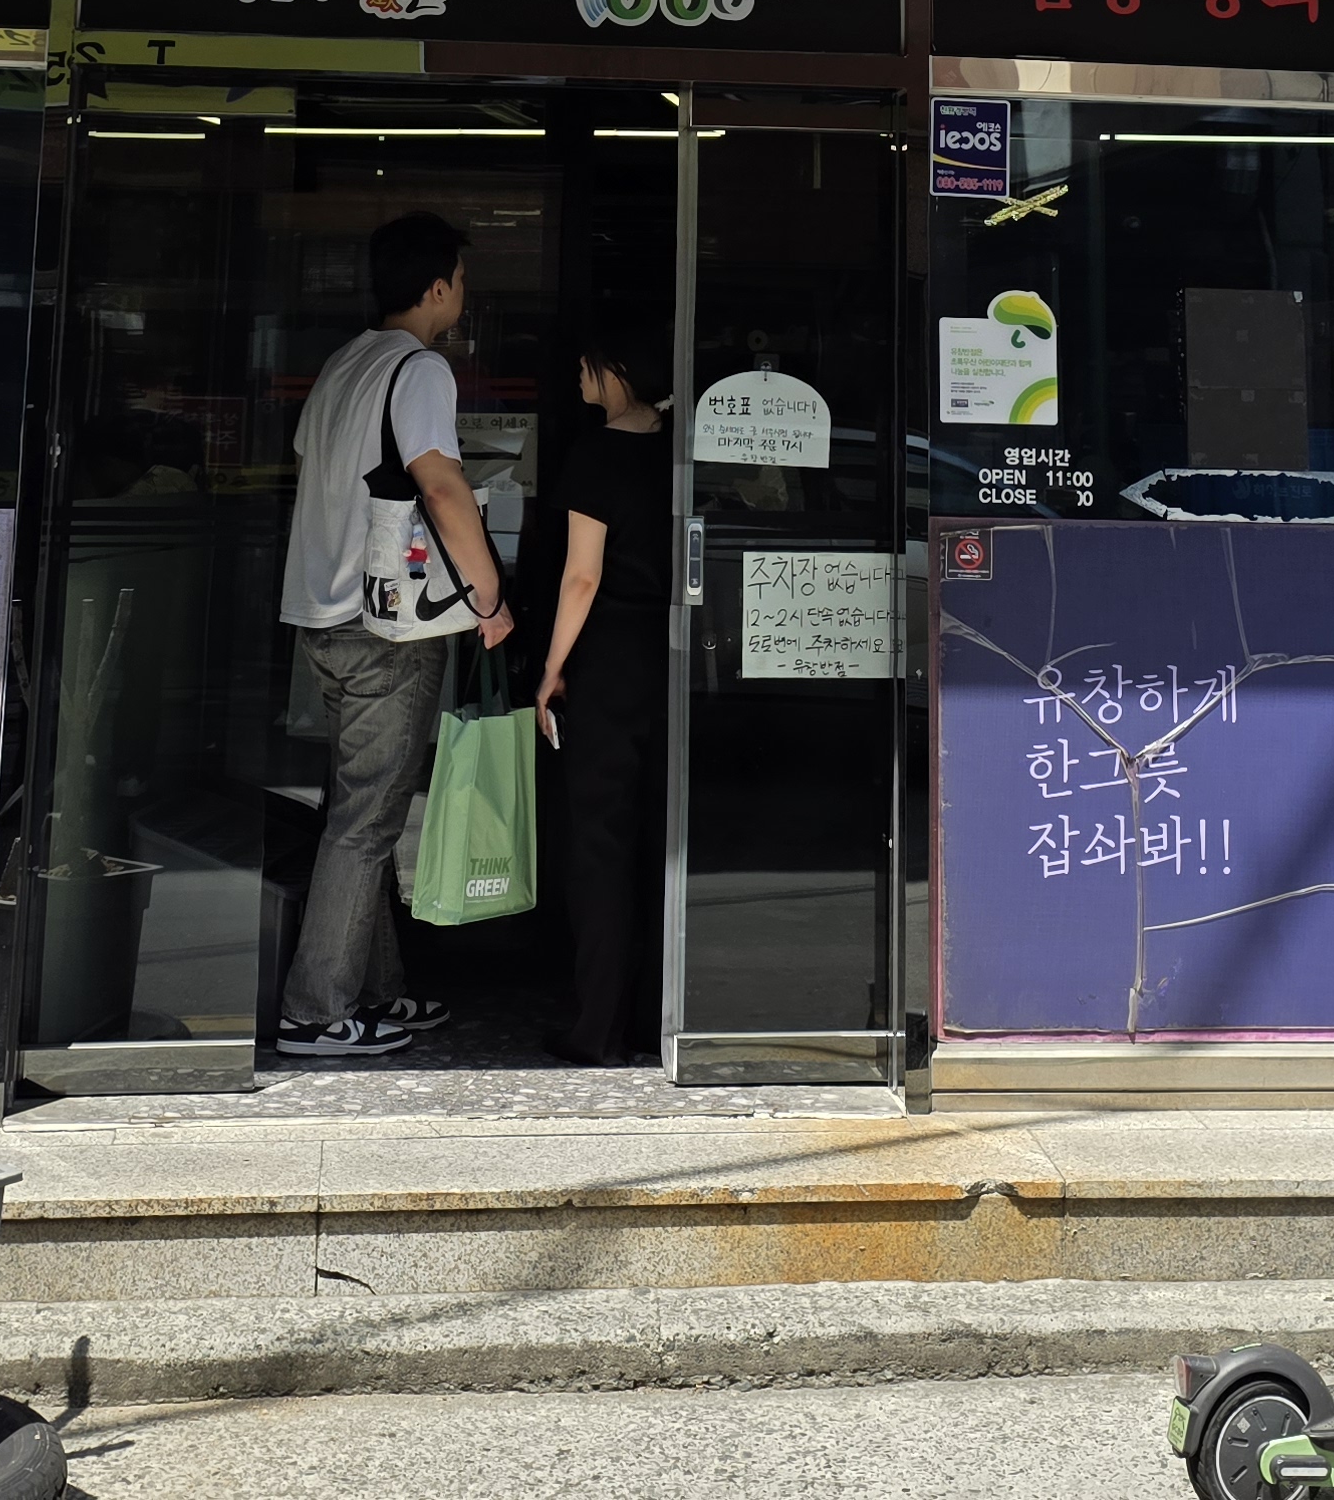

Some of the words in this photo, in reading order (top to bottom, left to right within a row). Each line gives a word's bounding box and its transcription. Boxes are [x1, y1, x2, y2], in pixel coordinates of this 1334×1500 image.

[709, 395, 752, 416] 번호표
[762, 397, 817, 420] 없습니다!
[718, 437, 754, 451] 마지막
[782, 440, 802, 453] 7시
[1004, 447, 1071, 467] 영업시간
[978, 468, 1027, 485] OPEN
[1046, 470, 1094, 487] 11:00
[978, 487, 1037, 505] CLOSE
[747, 556, 818, 599] 주차장
[824, 561, 891, 595] 없습니다
[747, 608, 803, 628] 12~2시
[807, 607, 834, 627] 단속
[806, 635, 886, 657] 주차하세요
[1023, 664, 1239, 724] 유창하게
[470, 856, 513, 875] THINK
[465, 878, 510, 897] GREEN
